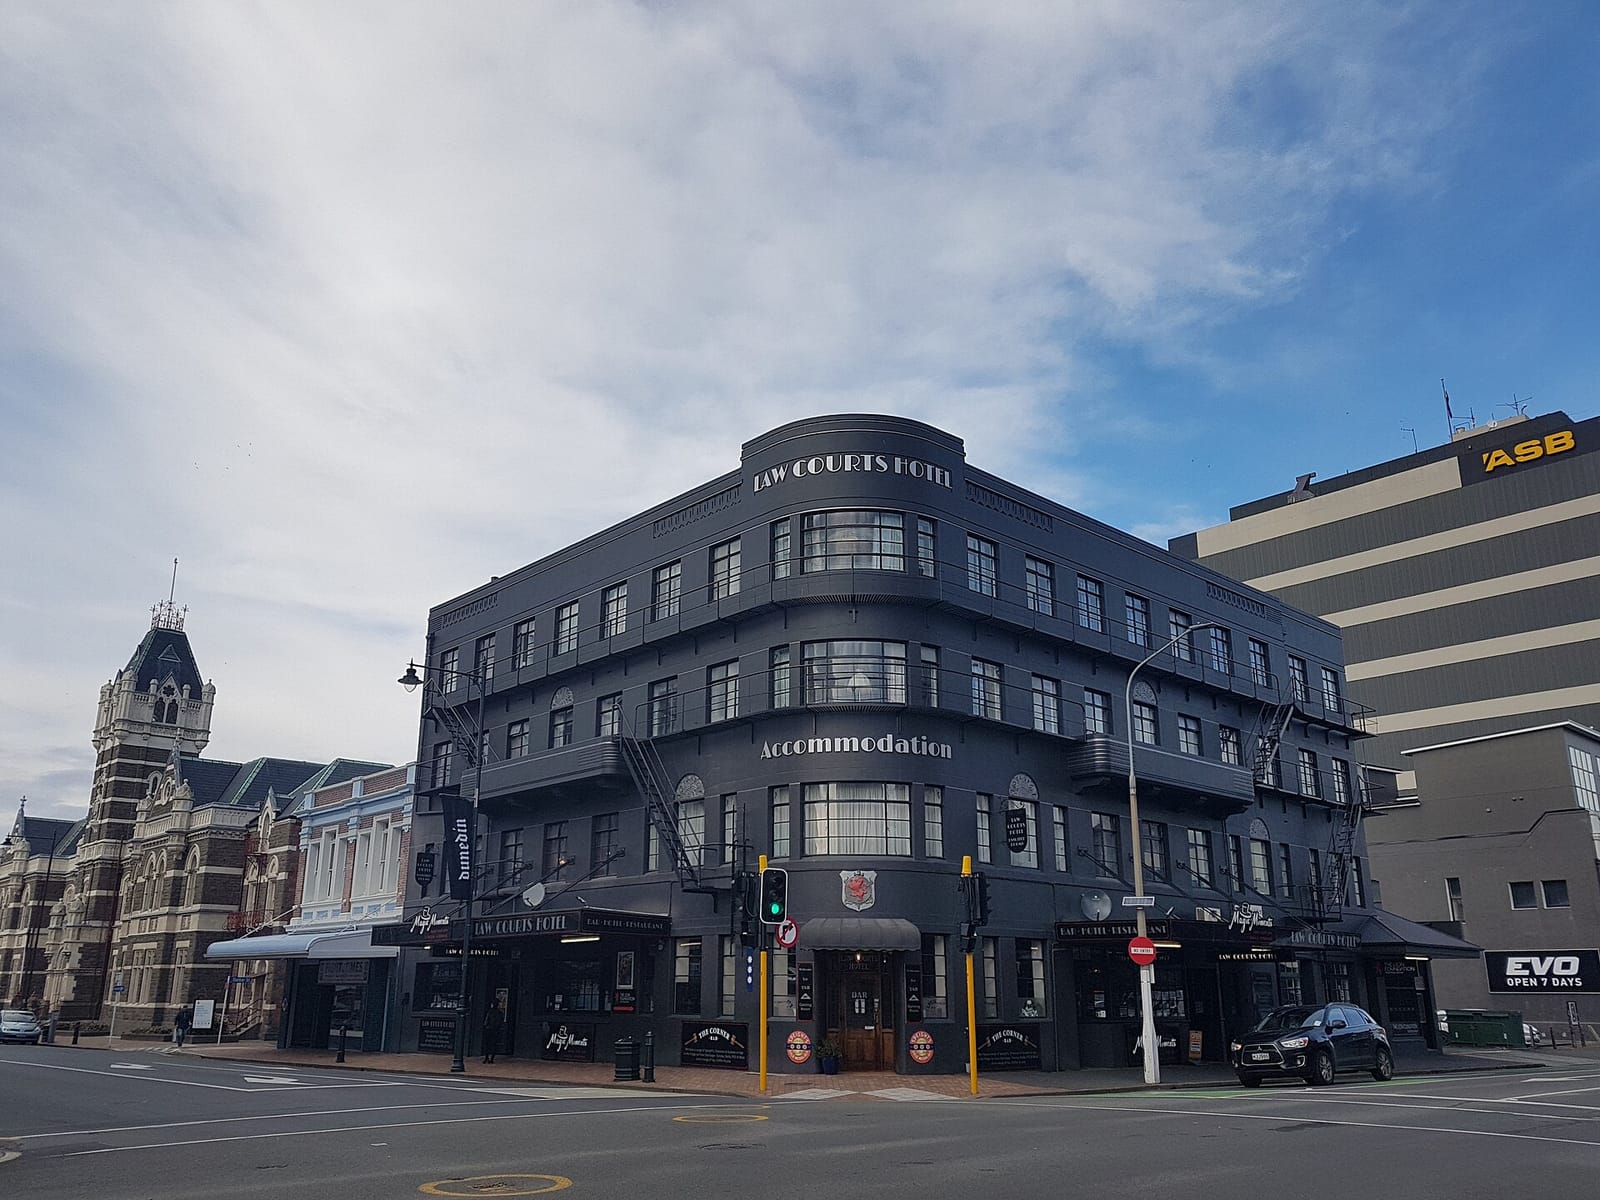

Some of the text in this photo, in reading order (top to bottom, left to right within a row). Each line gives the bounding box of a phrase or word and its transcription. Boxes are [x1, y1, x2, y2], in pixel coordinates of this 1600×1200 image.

[1482, 430, 1576, 473] ASB
[754, 454, 953, 493] LAW COURTS HOTEL
[760, 733, 952, 760] Accommodation
[452, 818, 470, 880] dunedin
[474, 915, 567, 936] LAW COURTS HOTEL
[1505, 956, 1580, 976] EVO
[1506, 977, 1583, 987] OPEN 7 DAYS
[709, 1027, 731, 1041] CORNER
